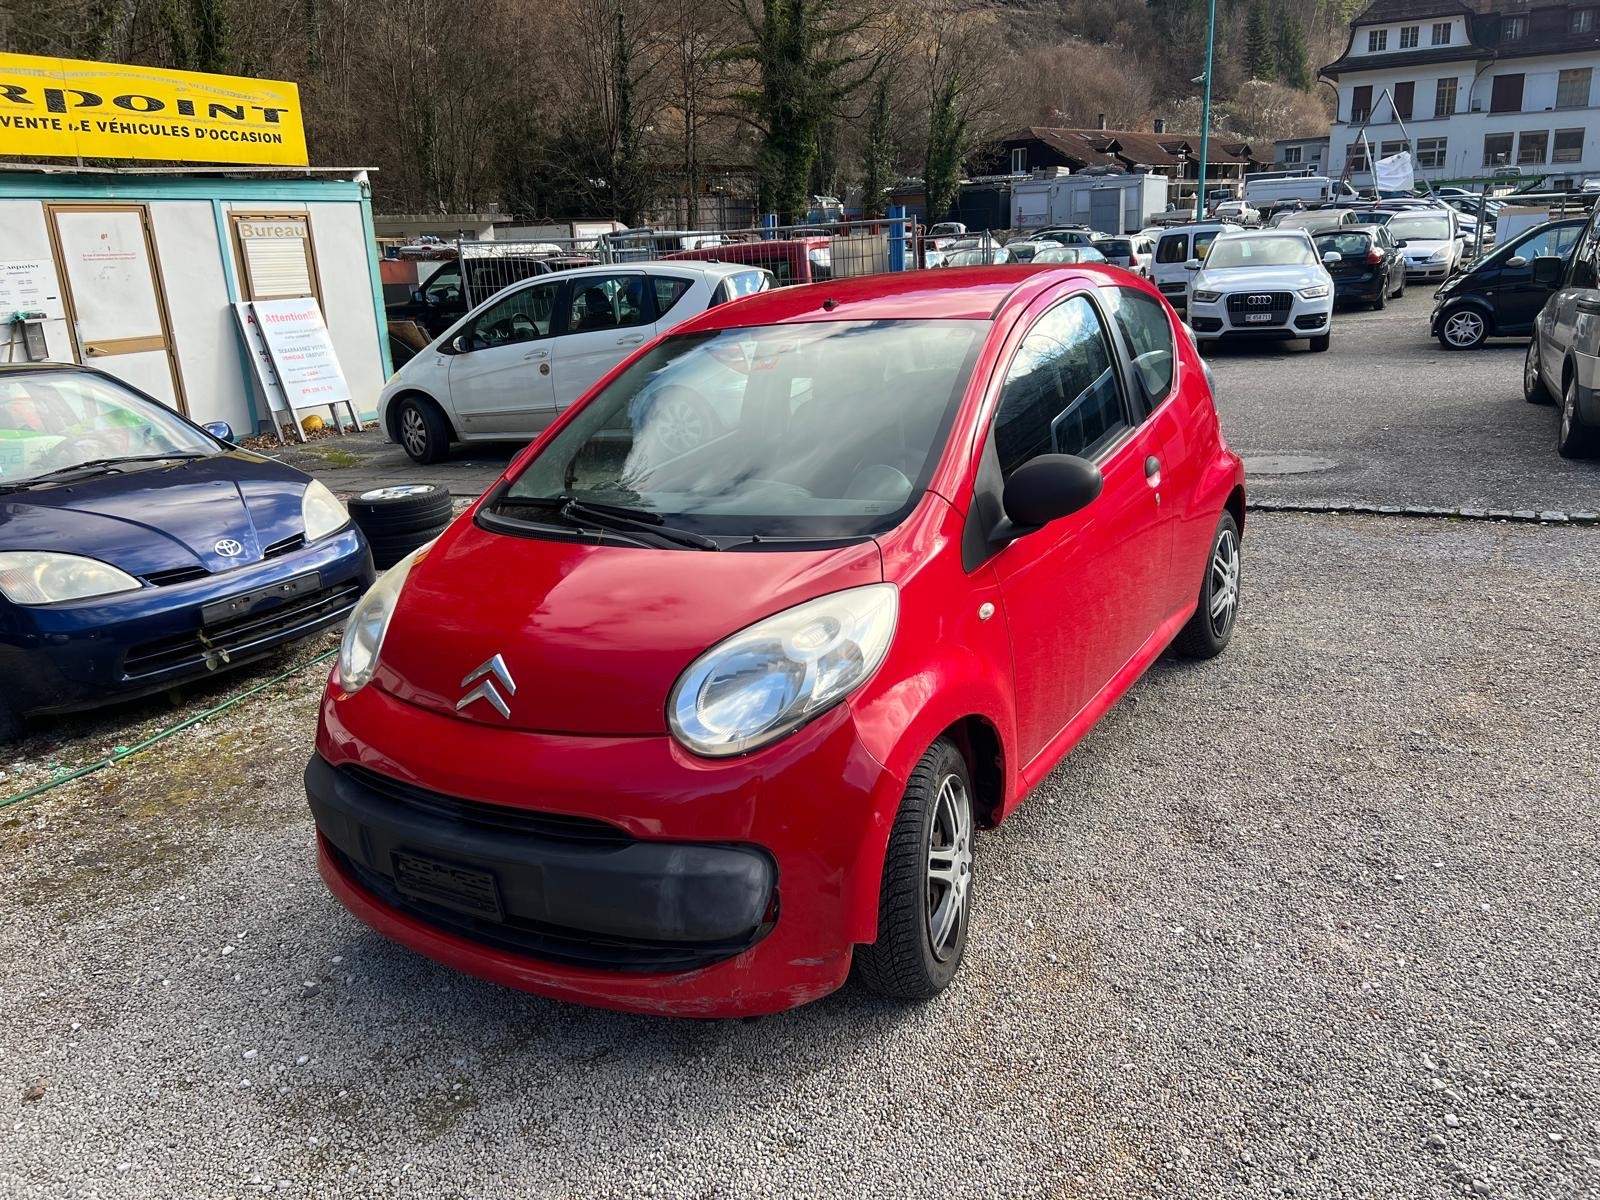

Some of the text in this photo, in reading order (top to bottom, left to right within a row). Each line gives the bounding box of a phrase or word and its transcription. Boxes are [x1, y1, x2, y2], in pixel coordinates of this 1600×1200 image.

[0, 115, 62, 131] VENTE
[97, 117, 190, 138] VÉHICULES
[195, 127, 283, 144] D'OCCASION
[240, 223, 305, 238] Bureau
